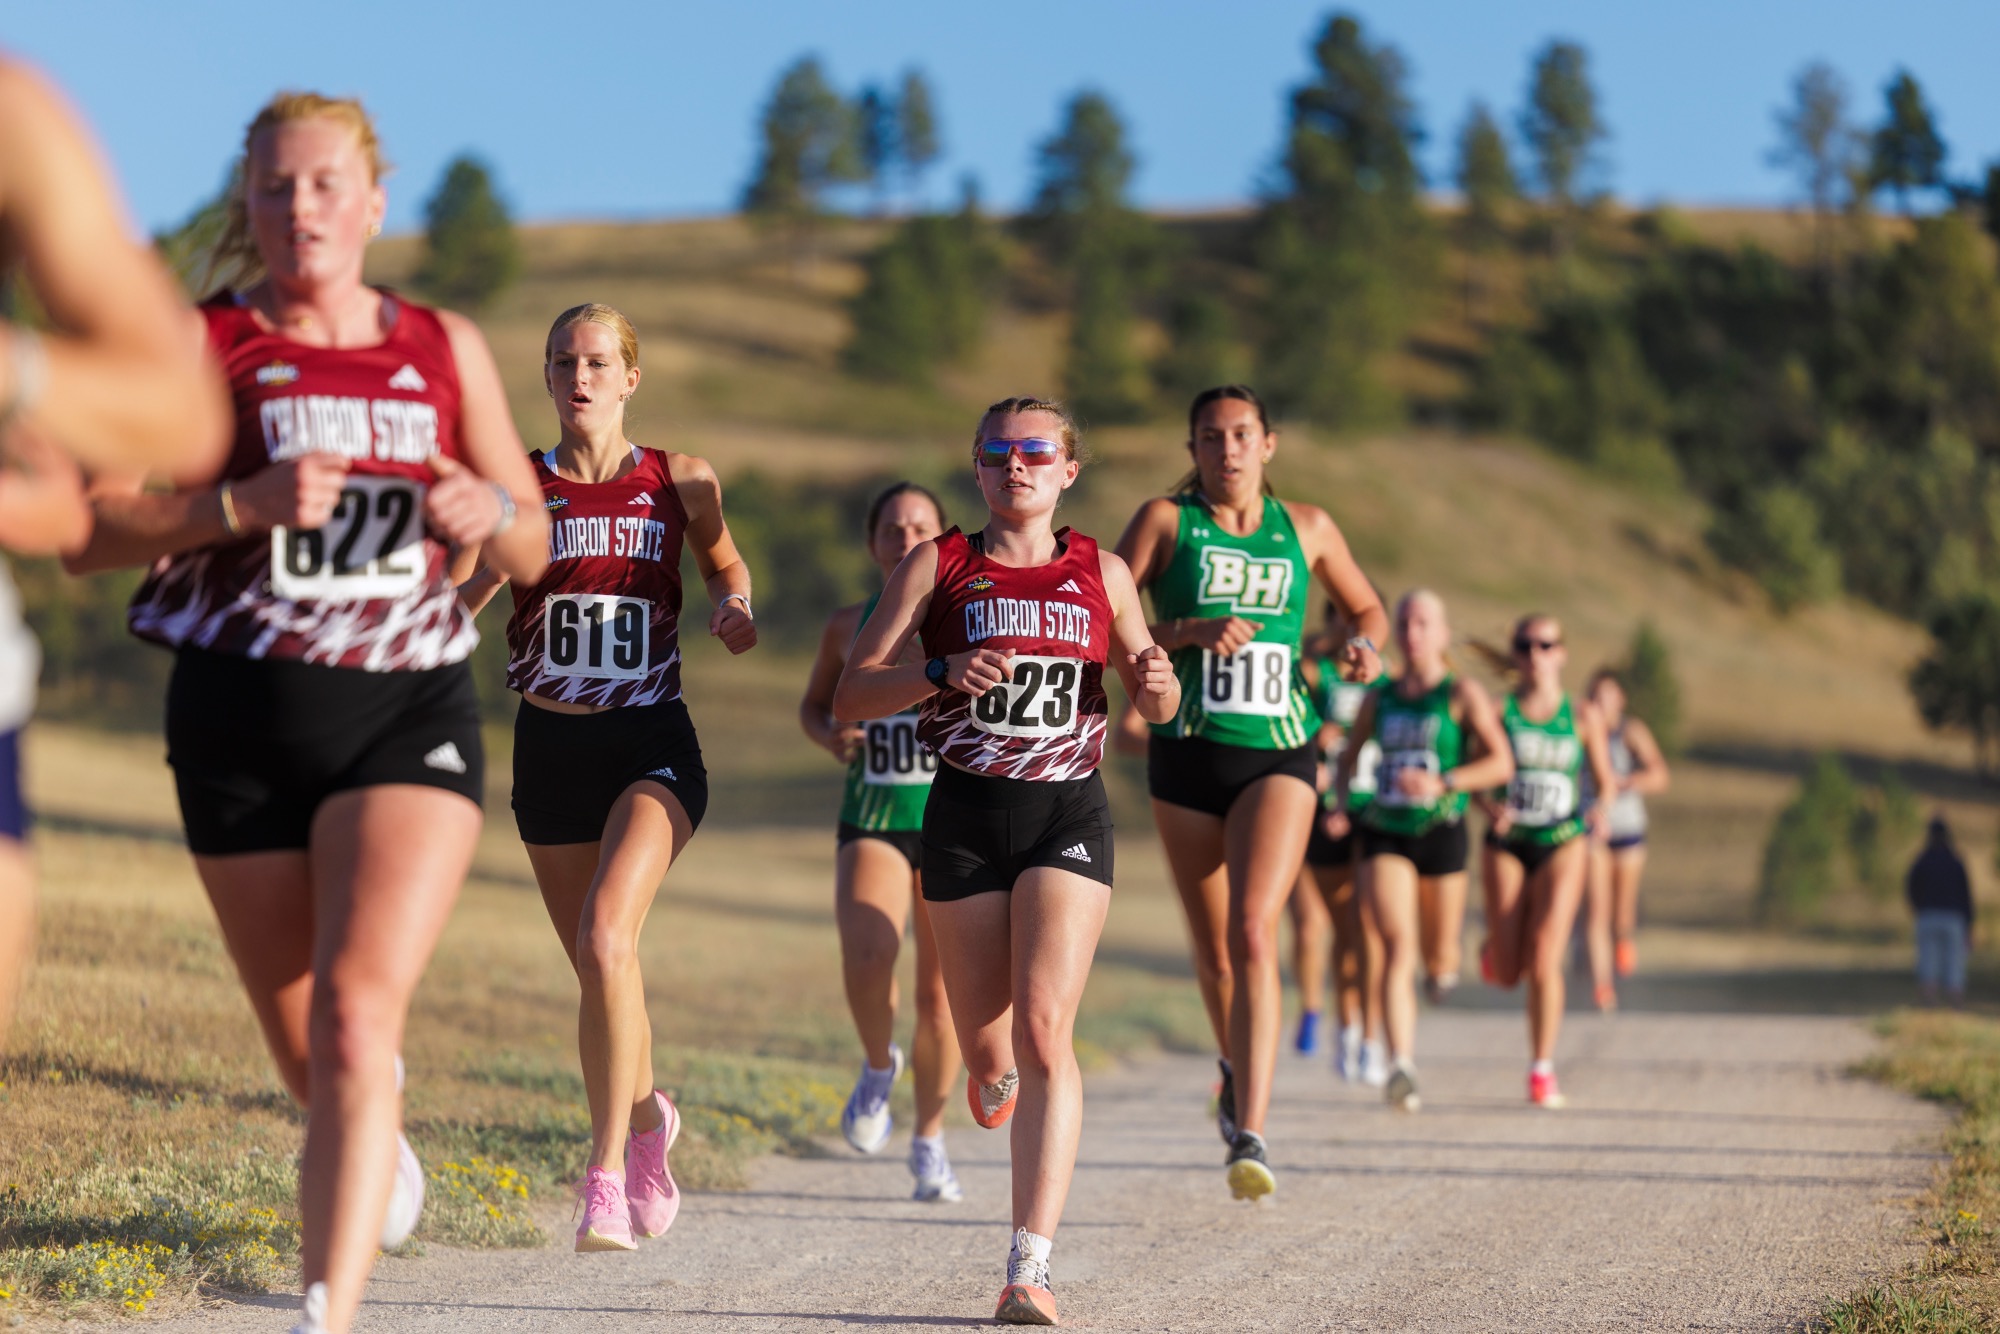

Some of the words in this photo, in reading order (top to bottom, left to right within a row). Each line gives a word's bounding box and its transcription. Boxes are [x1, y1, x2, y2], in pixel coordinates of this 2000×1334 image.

[549, 516, 610, 563] ADRON
[614, 516, 665, 562] STATE
[1203, 548, 1289, 611] BH
[549, 599, 644, 670] 619
[964, 597, 1040, 643] CHADRON
[1044, 600, 1091, 648] STATE
[975, 661, 1076, 728] 623
[1209, 650, 1284, 705] 618
[1061, 850, 1092, 863] adidas
